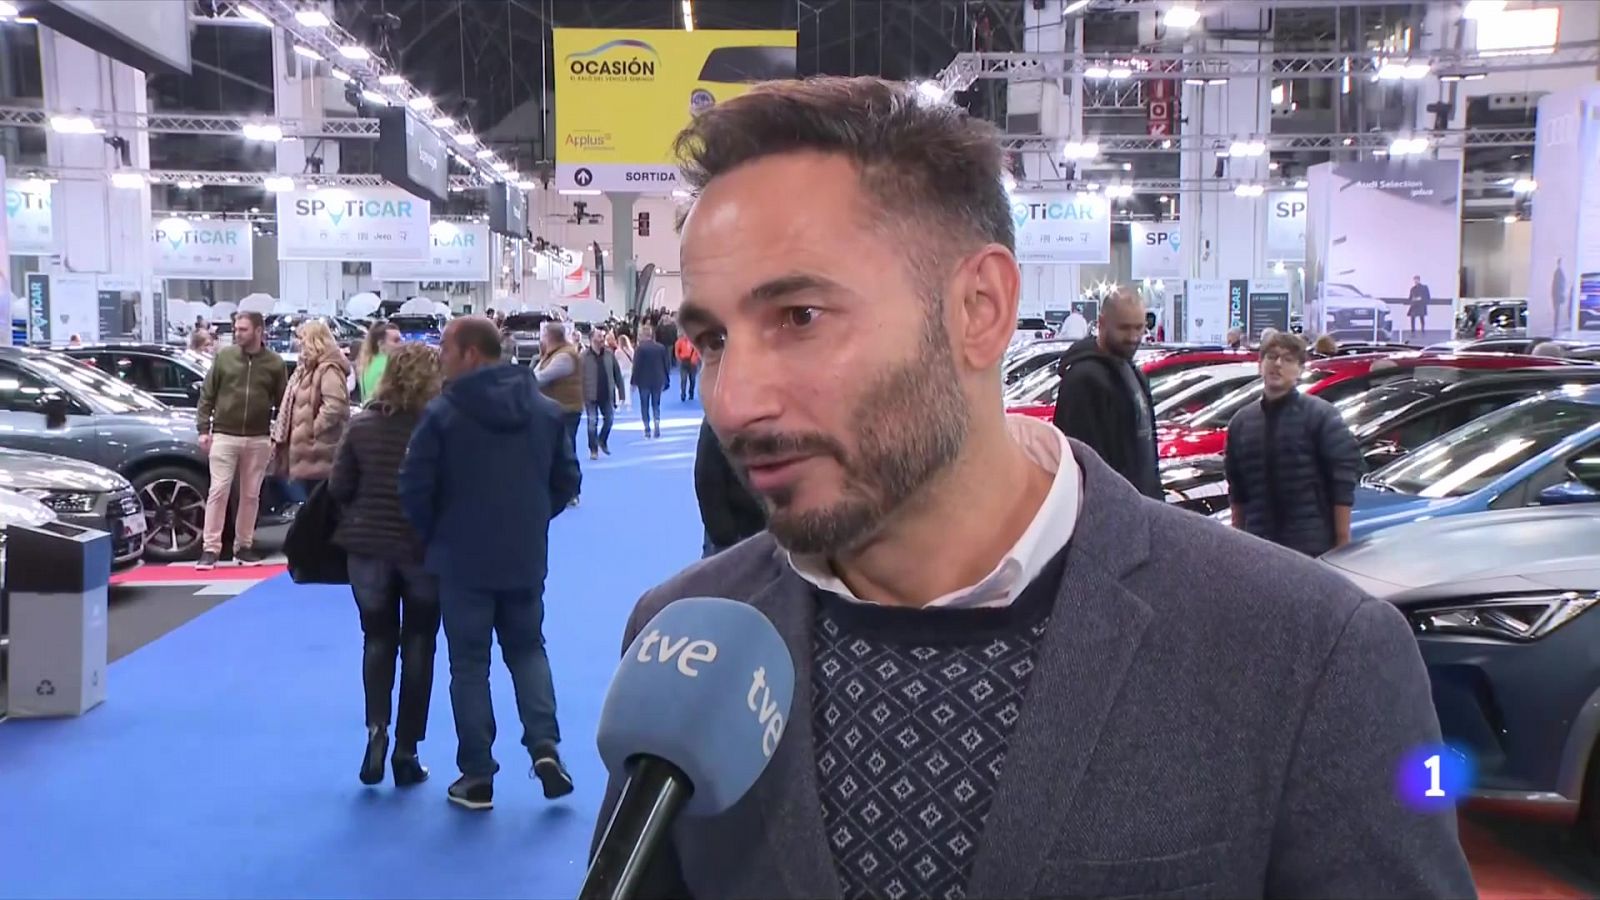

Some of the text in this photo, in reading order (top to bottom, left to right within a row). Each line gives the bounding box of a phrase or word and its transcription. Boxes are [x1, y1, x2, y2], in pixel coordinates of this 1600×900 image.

[571, 57, 655, 76] OCASIÓN
[565, 133, 604, 148] Applus
[625, 171, 676, 181] SORTIDA
[1356, 180, 1423, 189] Audi Selection
[1276, 201, 1305, 218] SP
[637, 629, 717, 677] tve
[747, 666, 784, 757] tve
